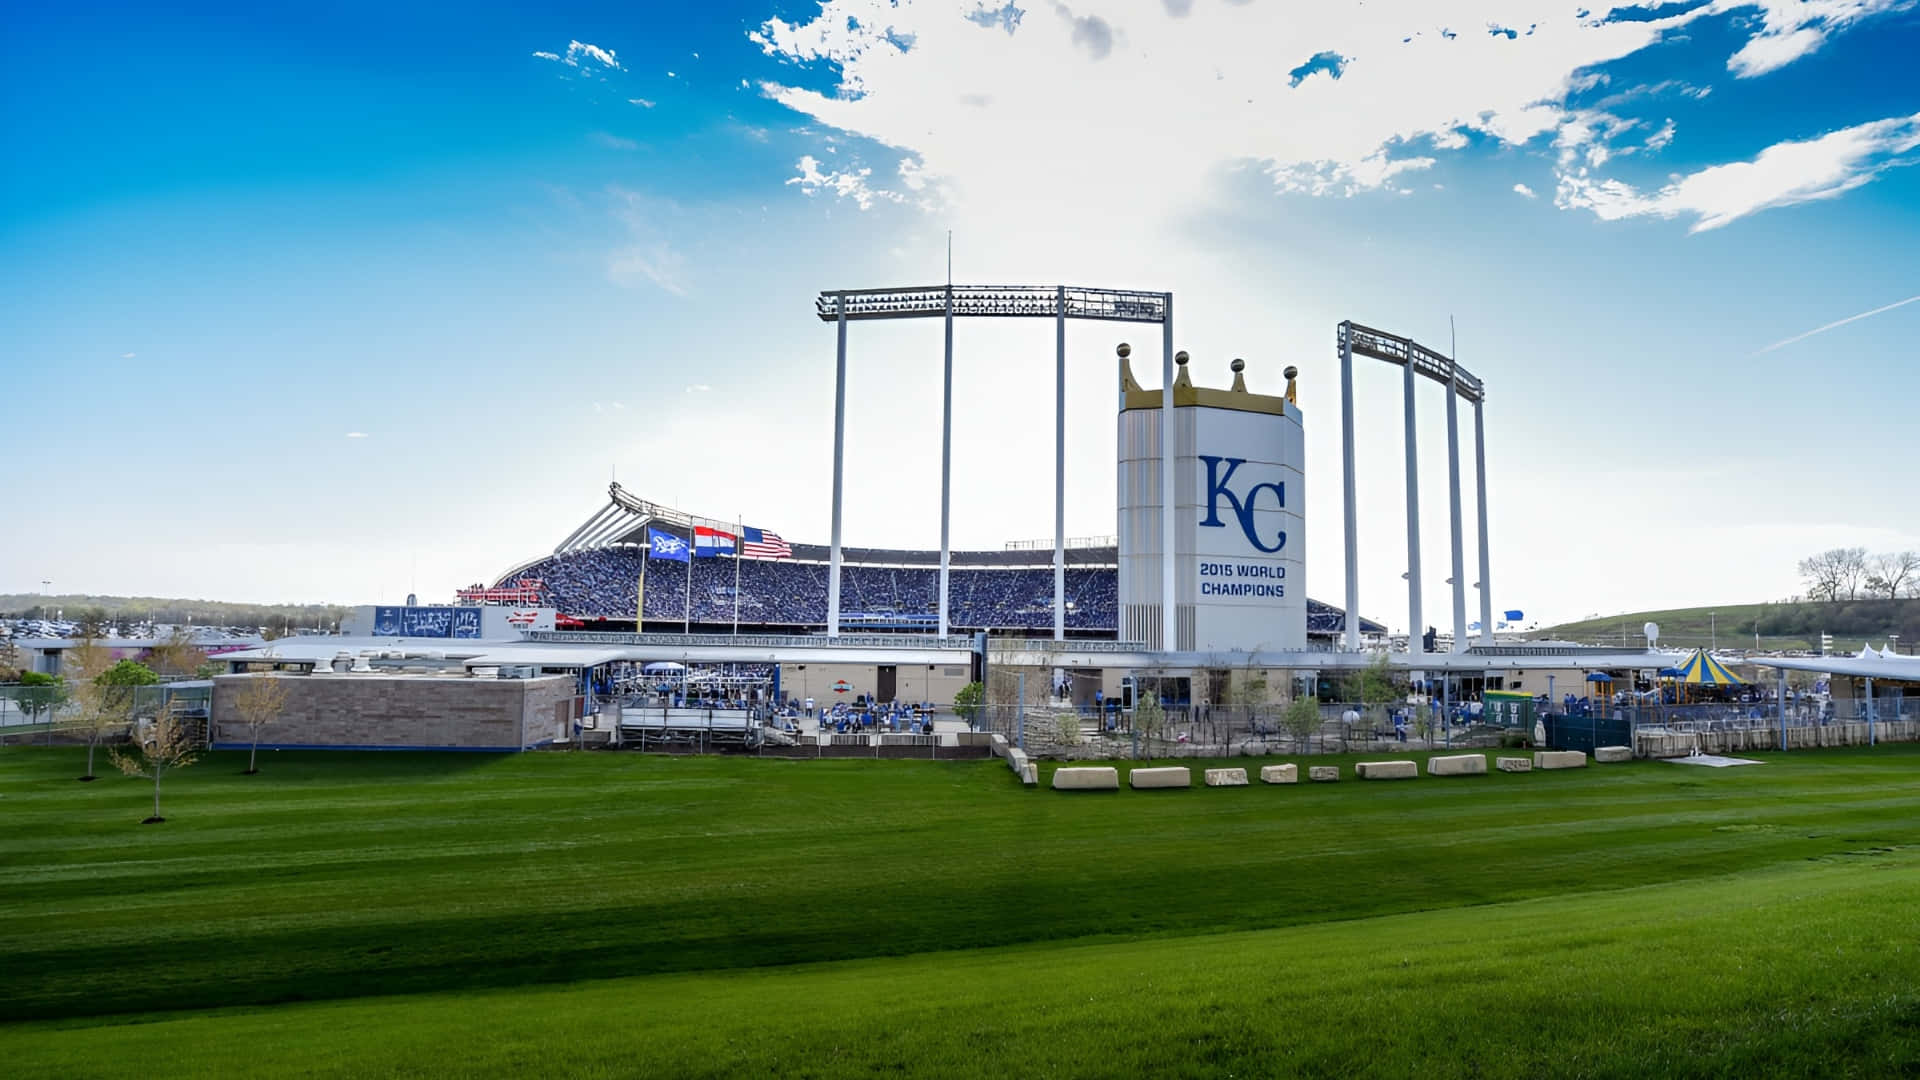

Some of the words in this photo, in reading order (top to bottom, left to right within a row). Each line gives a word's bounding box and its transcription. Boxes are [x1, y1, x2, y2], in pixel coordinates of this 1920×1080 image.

[1198, 456, 1286, 553] KC
[1200, 563, 1232, 576] 2015
[1237, 565, 1285, 579] WORLD
[1202, 583, 1284, 597] CHAMPIONS
